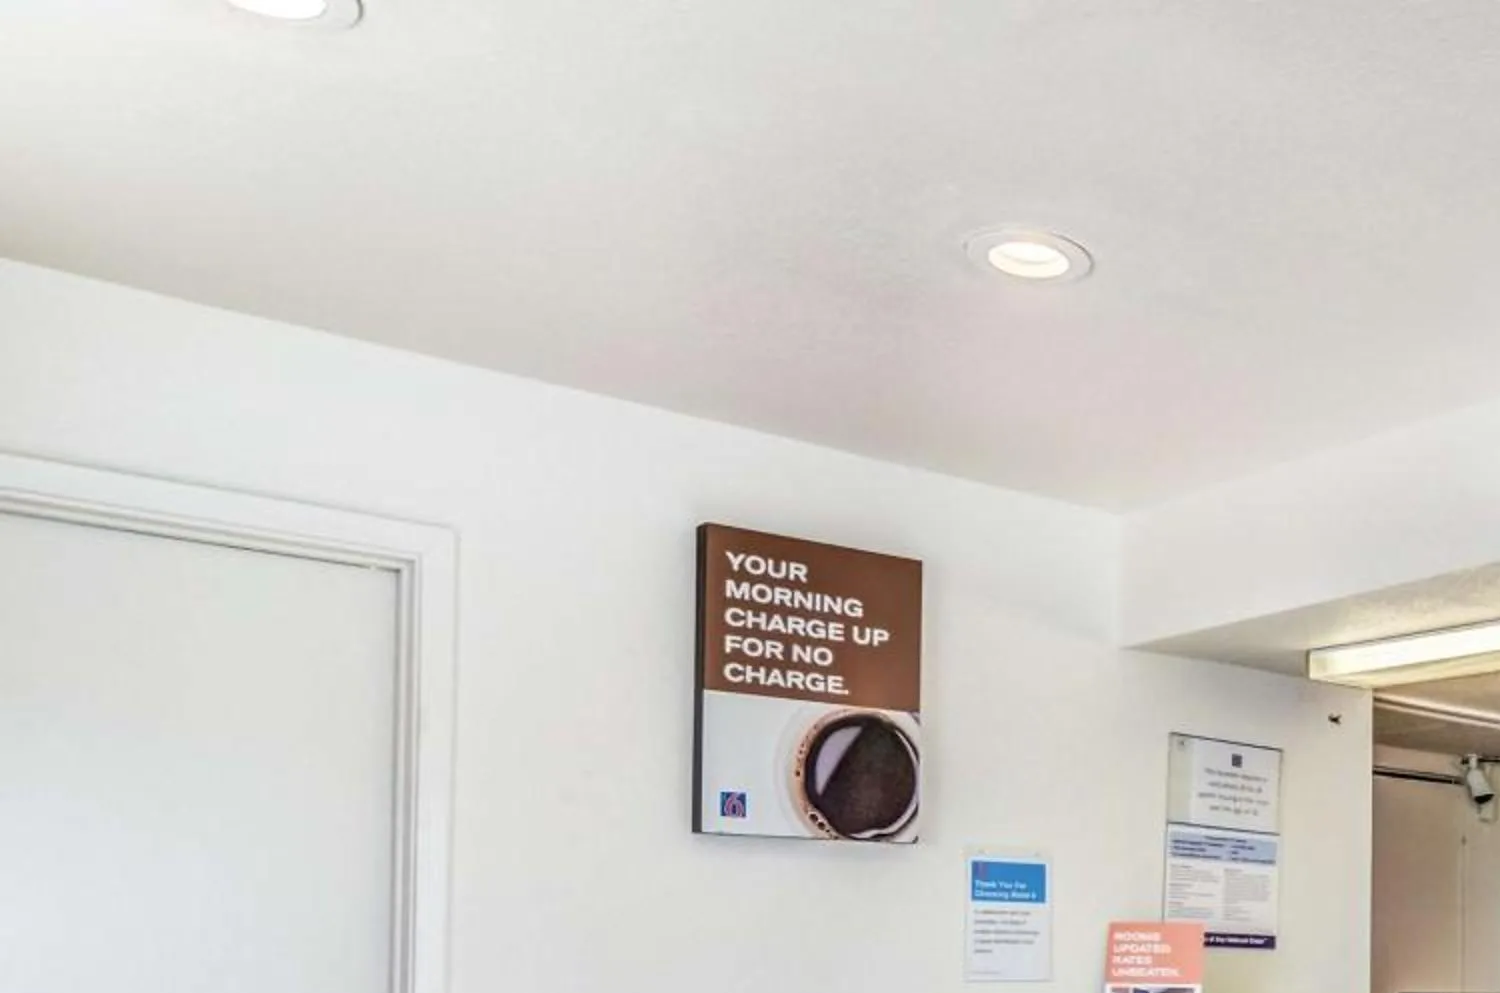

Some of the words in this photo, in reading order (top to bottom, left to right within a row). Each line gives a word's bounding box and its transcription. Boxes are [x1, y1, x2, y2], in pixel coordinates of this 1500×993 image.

[725, 551, 808, 583] YOUR
[725, 579, 864, 617] MORNING
[725, 607, 845, 641] CHARGE
[852, 626, 890, 647] UP
[725, 635, 784, 661] FOR
[792, 644, 833, 666] NO
[723, 663, 849, 695] CHARGE.
[1113, 931, 1161, 942] ROOMS
[1112, 955, 1153, 965] RATES
